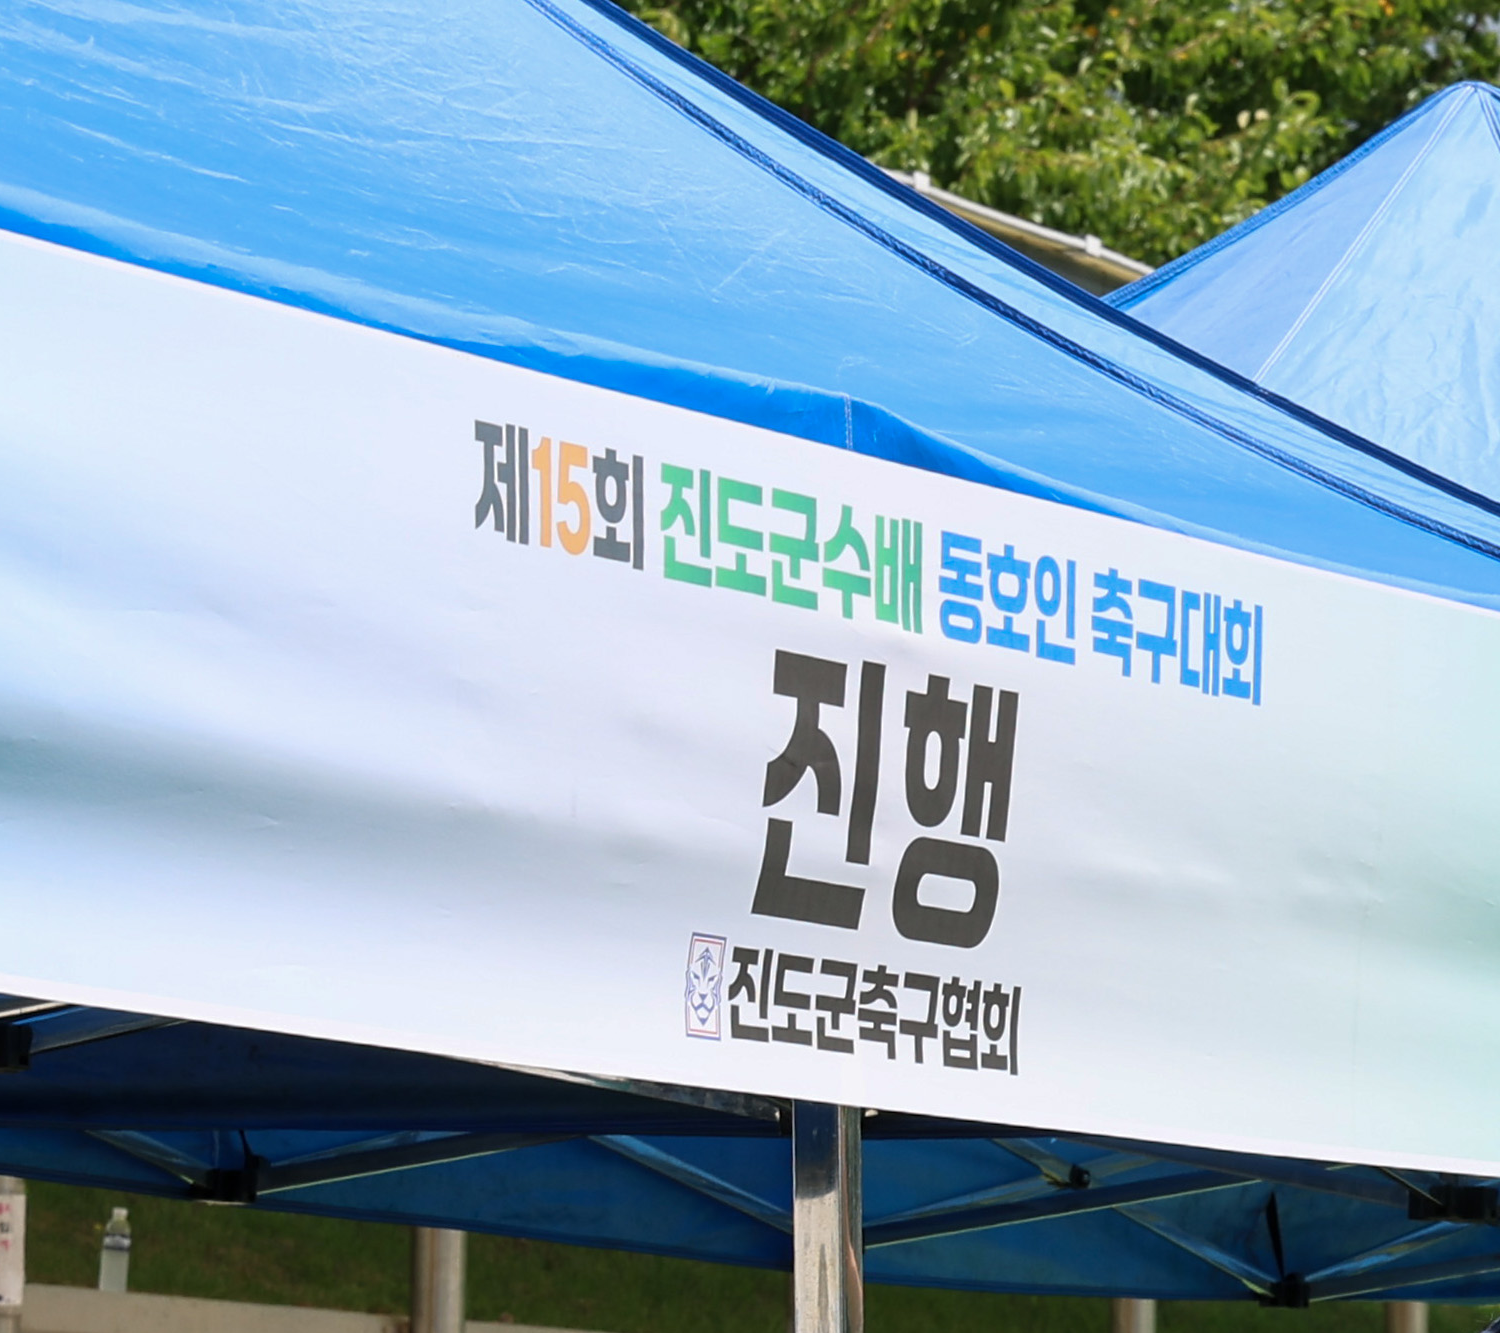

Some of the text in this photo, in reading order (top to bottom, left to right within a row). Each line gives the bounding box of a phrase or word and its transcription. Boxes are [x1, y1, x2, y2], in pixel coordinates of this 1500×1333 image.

[474, 419, 1264, 706] 제15회 진도군수배 동호인 축구대회
[750, 648, 1020, 948] 진행
[727, 946, 1022, 1076] 진도군축구협회
